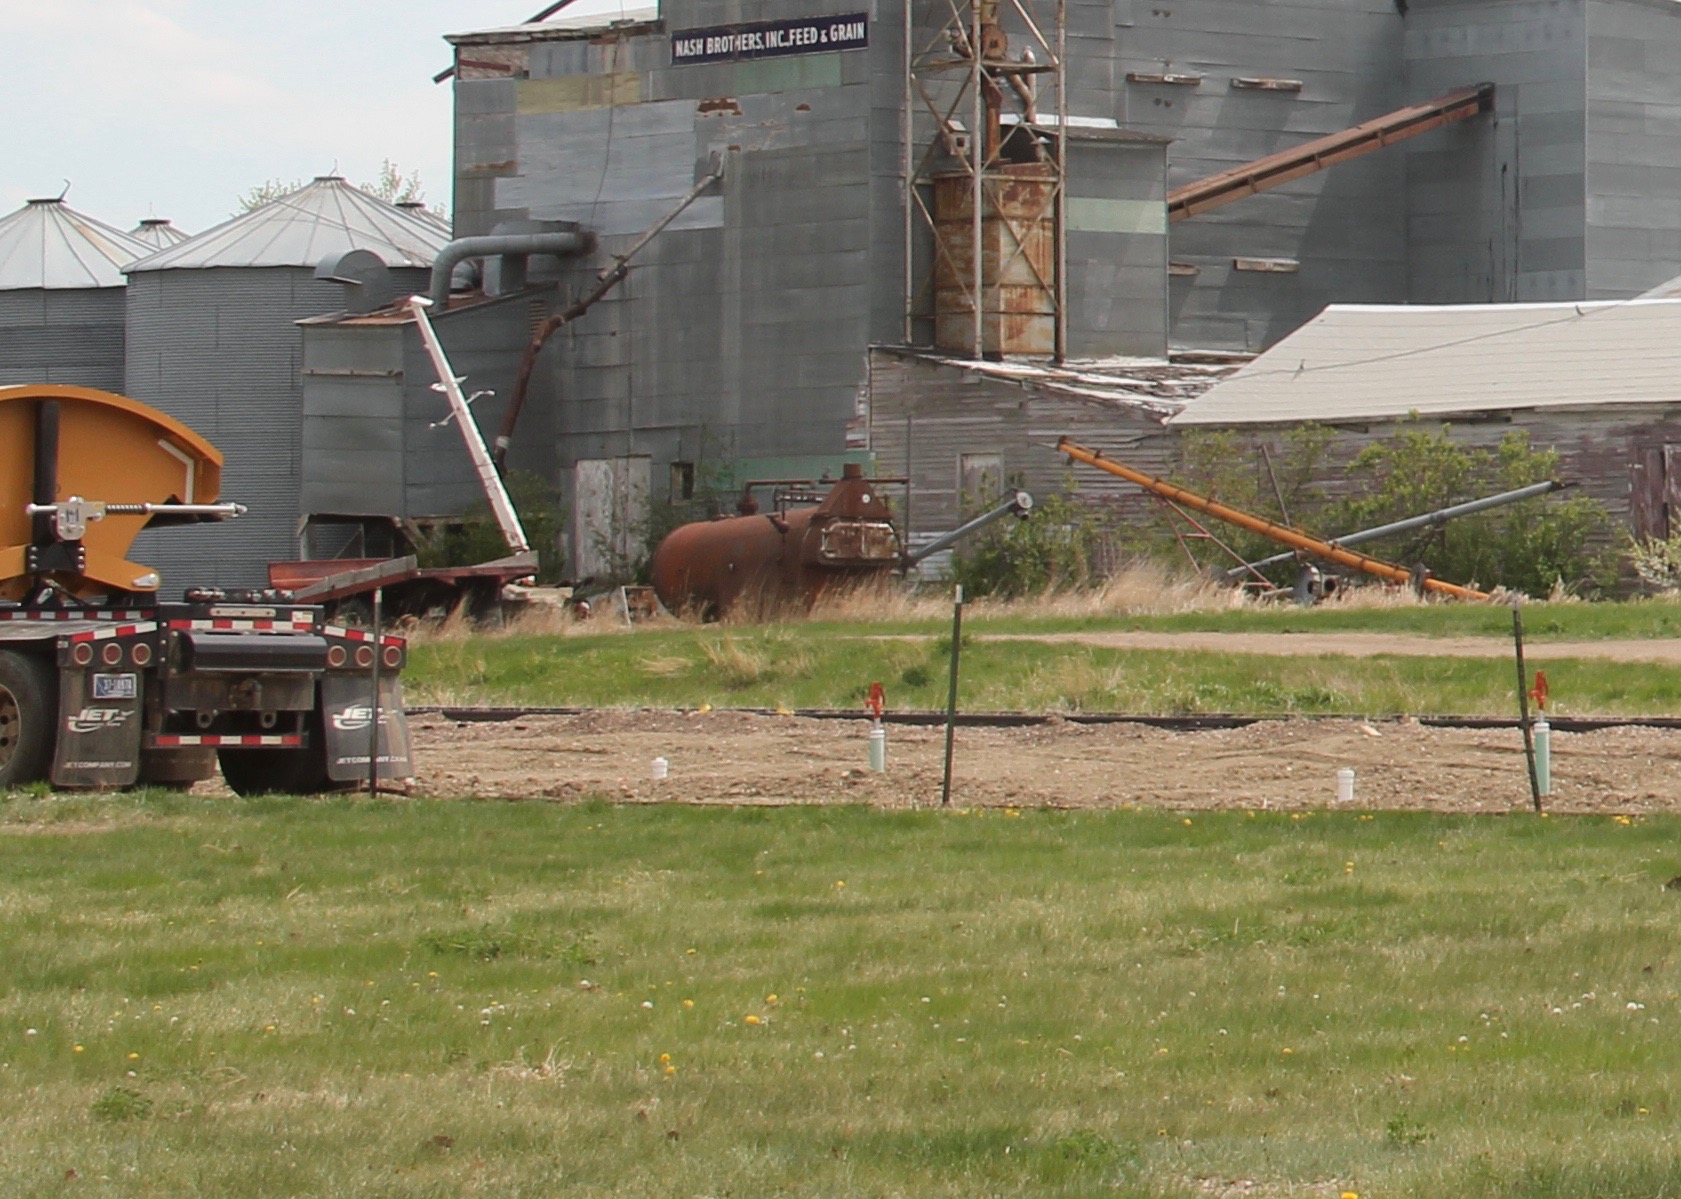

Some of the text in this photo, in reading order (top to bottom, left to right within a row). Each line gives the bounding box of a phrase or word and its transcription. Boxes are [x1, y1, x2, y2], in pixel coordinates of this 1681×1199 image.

[676, 38, 704, 57] NASH
[820, 29, 829, 43] &
[830, 22, 865, 42] GRAIN
